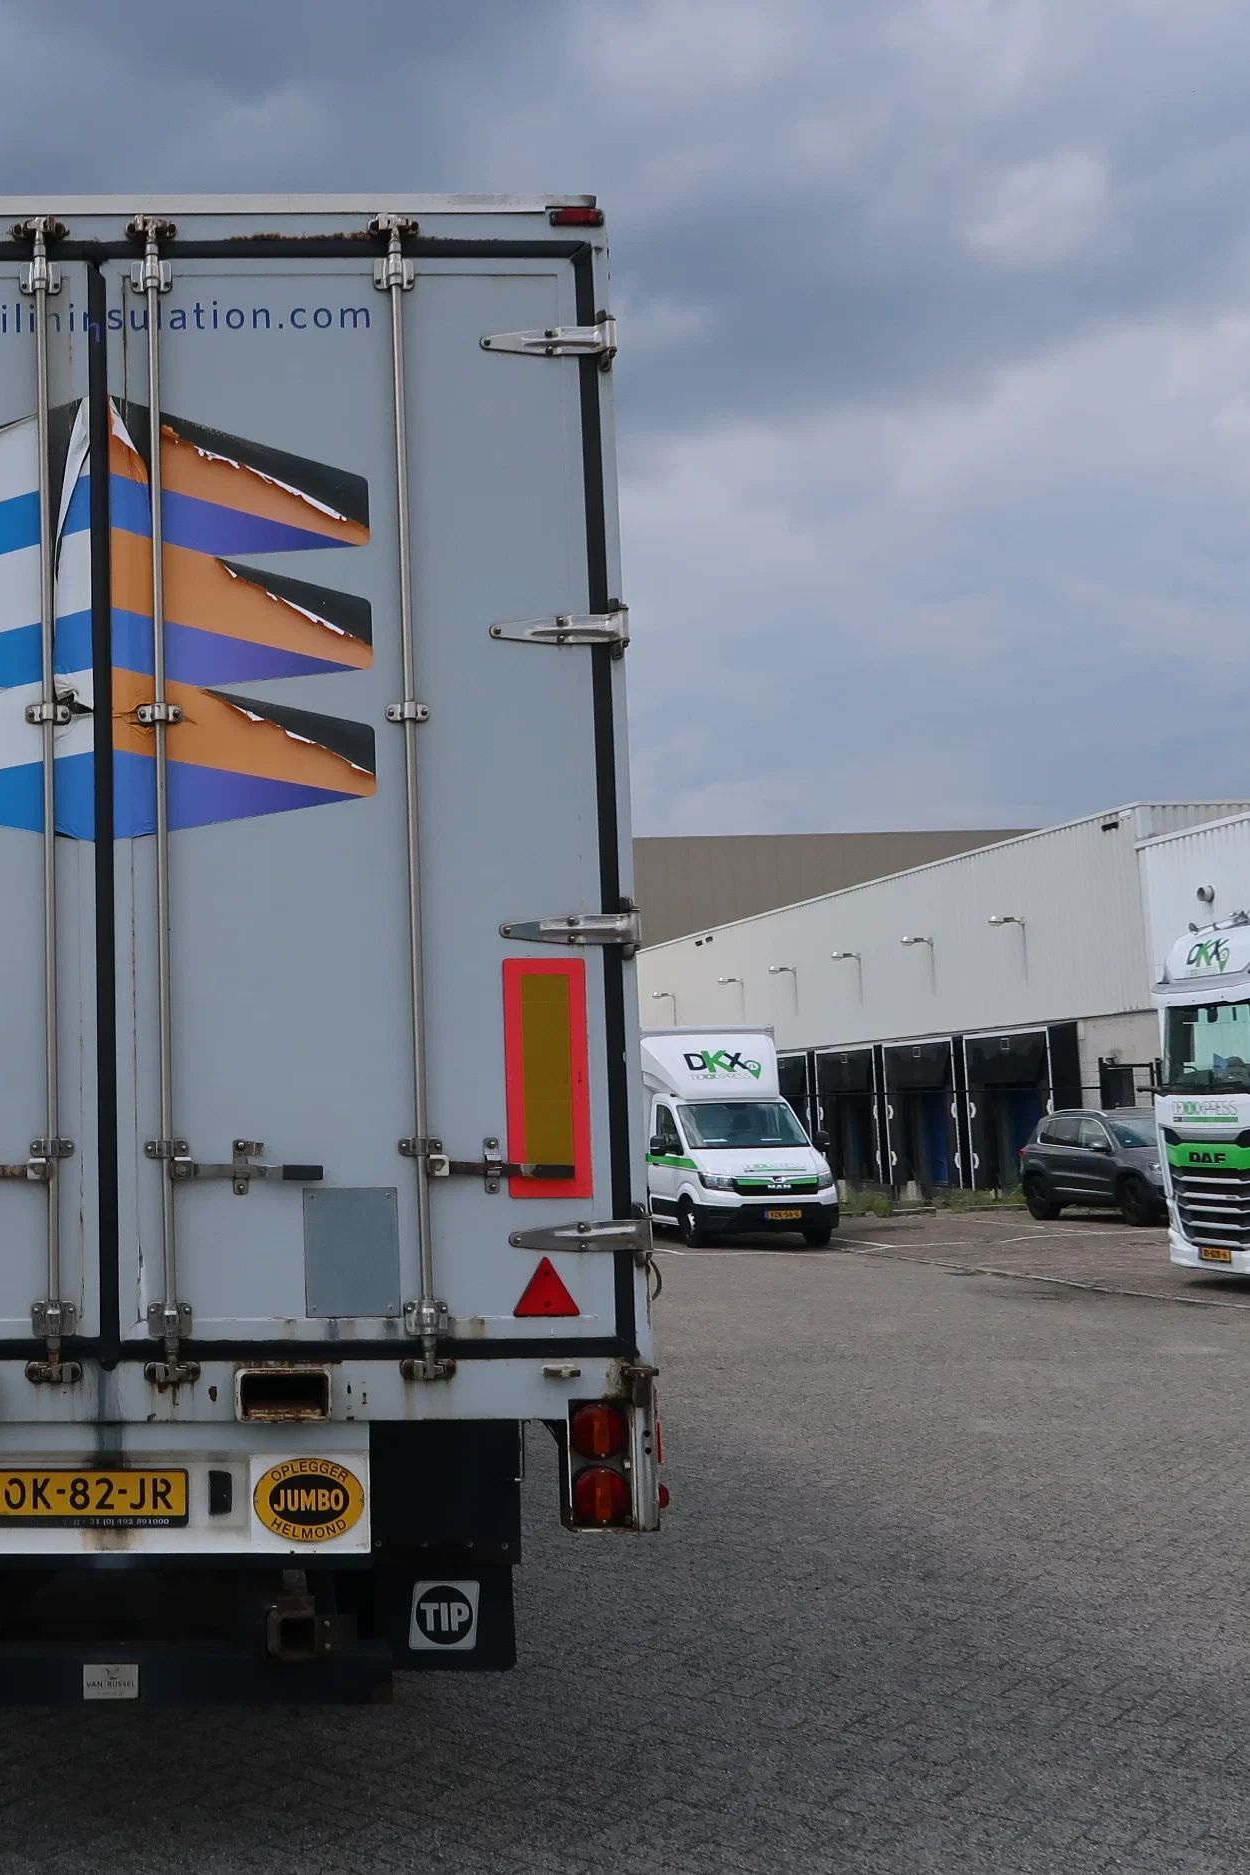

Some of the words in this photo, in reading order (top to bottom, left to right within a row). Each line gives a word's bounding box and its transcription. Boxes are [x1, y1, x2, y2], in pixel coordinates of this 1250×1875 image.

[683, 1050, 750, 1073] DKX
[1189, 1152, 1226, 1163] DAF
[271, 1461, 348, 1483] OPLEGGER
[4, 1478, 173, 1510] OK-82-JR
[273, 1489, 344, 1511] JUMBO
[271, 1518, 347, 1539] HELMOND
[420, 1602, 469, 1632] TIP
